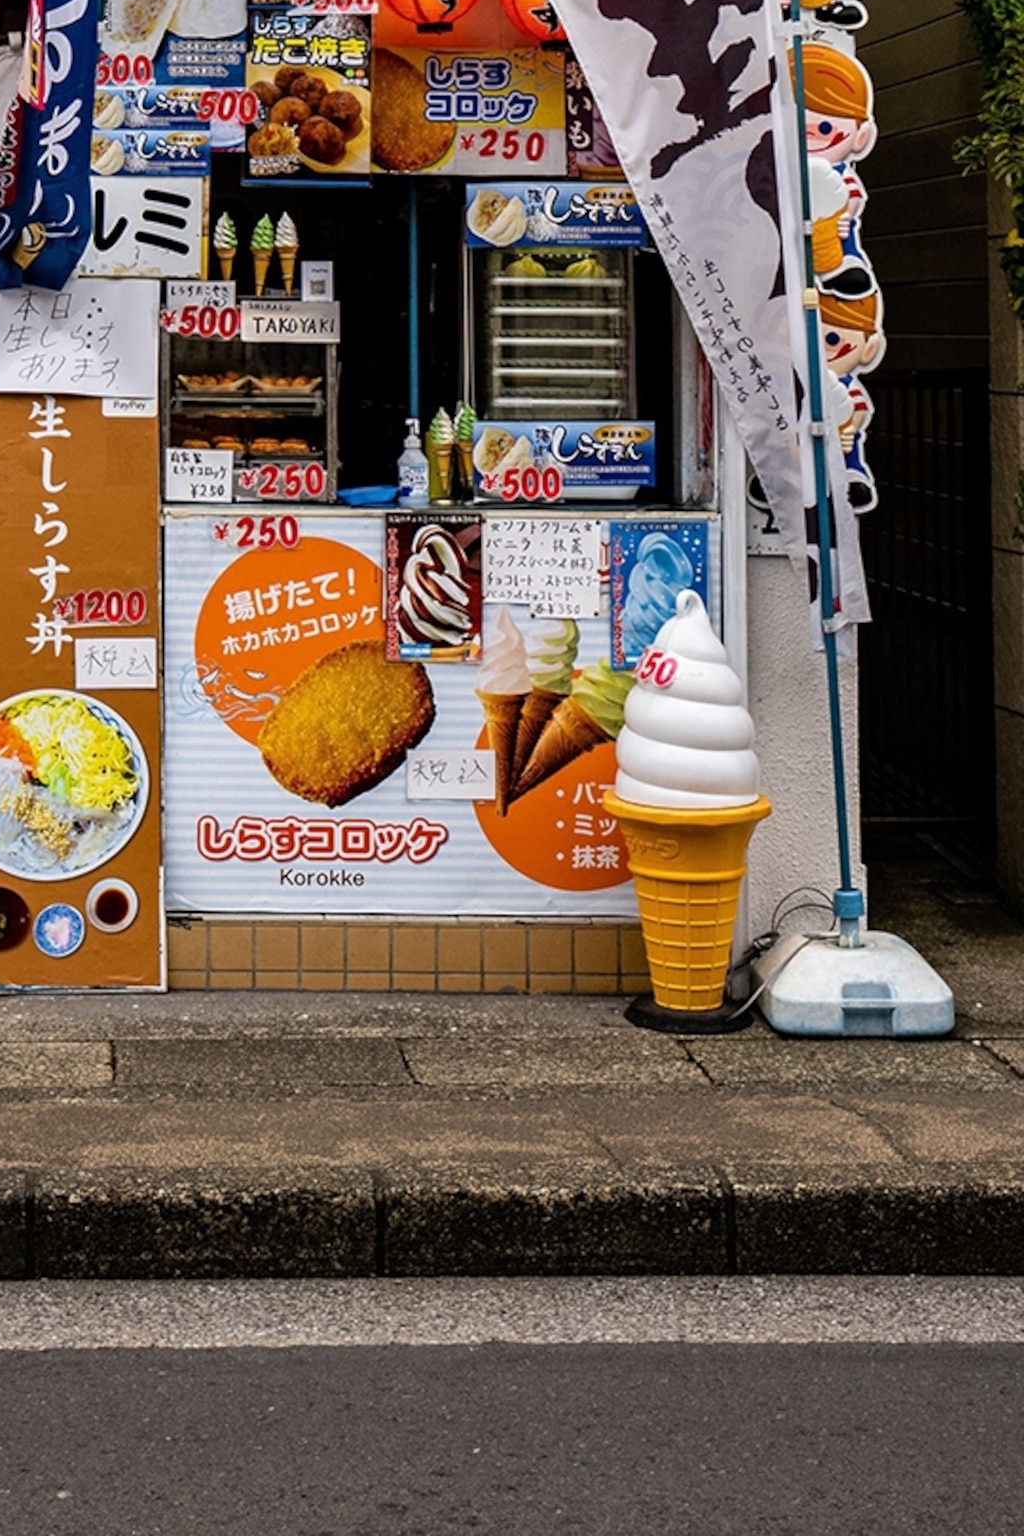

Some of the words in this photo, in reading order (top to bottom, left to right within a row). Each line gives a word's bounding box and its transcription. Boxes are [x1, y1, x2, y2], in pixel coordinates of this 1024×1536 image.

[254, 14, 312, 36] しらす
[252, 35, 367, 66] たこ焼き
[425, 57, 510, 90] しらす
[198, 90, 258, 122] 500
[425, 91, 536, 124] コロッケ
[459, 127, 545, 162] ¥250
[544, 185, 634, 224] しらすまん
[12, 289, 74, 322] 本日
[161, 305, 240, 338] ¥500
[3, 322, 115, 355] 生しらす
[252, 316, 336, 335] TAKOYAKI
[112, 400, 146, 411] PayPay
[551, 424, 642, 463] しらすまん
[240, 463, 325, 498] ¥250
[483, 465, 563, 501] ¥500
[26, 394, 74, 658] 生しらす丼
[212, 515, 300, 549] ¥250
[54, 589, 147, 624] ¥1200
[224, 566, 357, 625] 揚げたて!
[221, 604, 379, 657] ホカホカコロッケ
[82, 646, 154, 678] 税込
[413, 758, 490, 785] 税込
[197, 816, 448, 862] しらすコロッケ
[571, 844, 621, 870] 抹茶
[279, 868, 365, 887] Korokke
